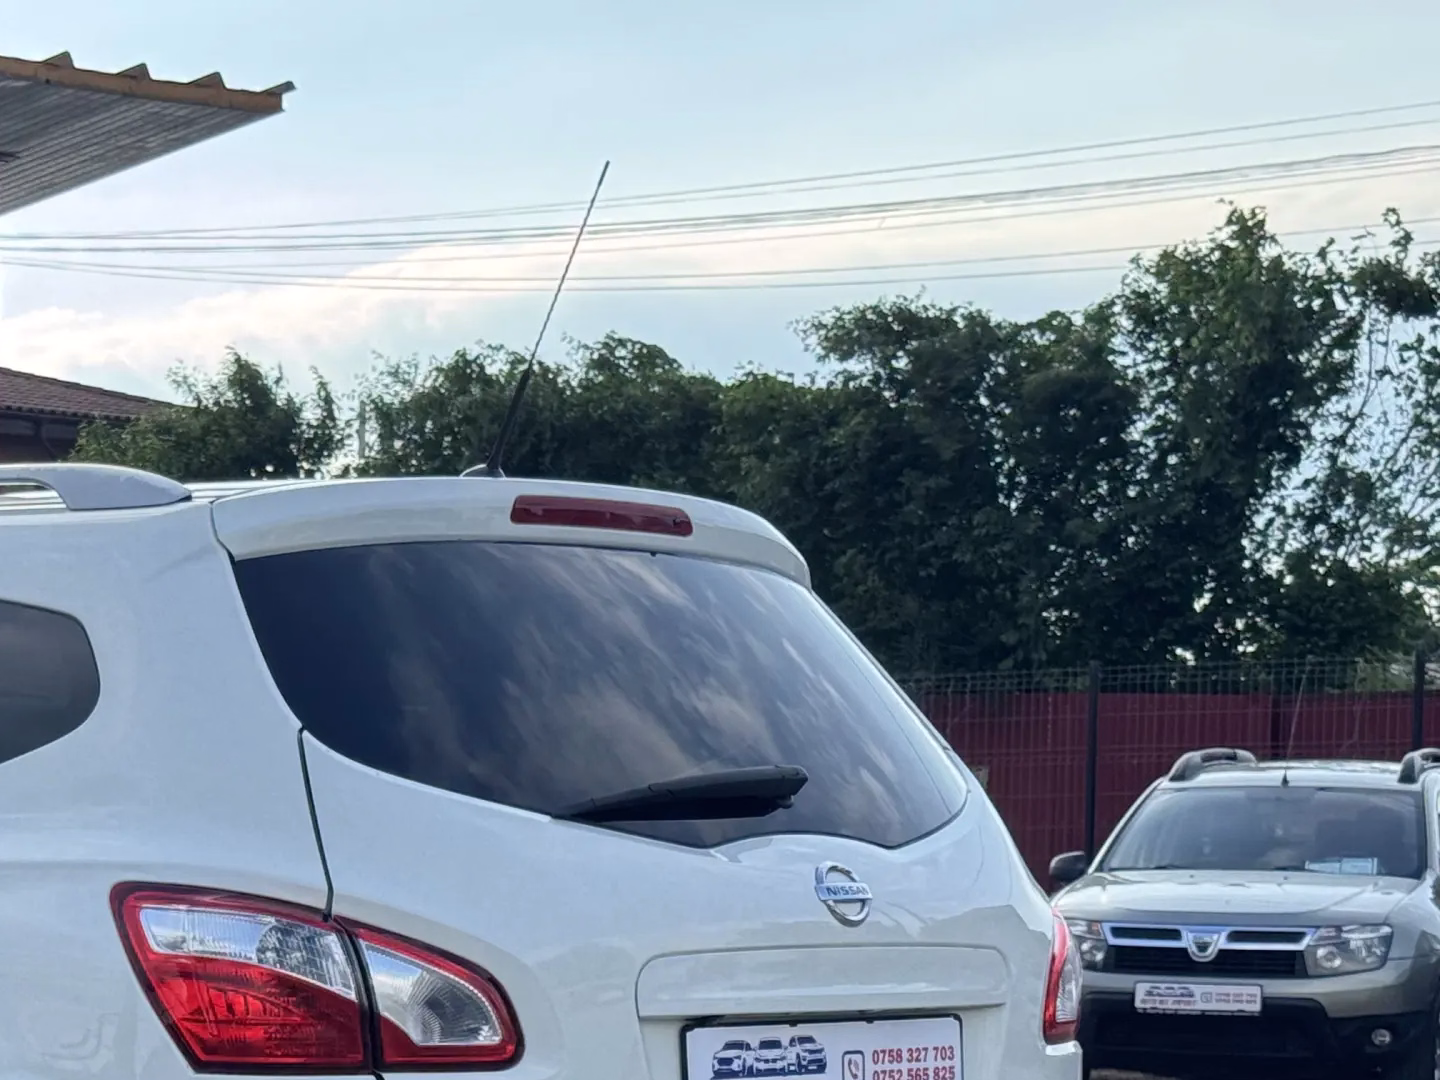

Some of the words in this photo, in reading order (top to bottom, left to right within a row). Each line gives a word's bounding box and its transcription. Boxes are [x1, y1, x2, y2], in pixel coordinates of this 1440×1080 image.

[825, 885, 870, 897] NISSAN
[872, 1048, 903, 1065] 0758
[906, 1046, 929, 1063] 327
[932, 1045, 955, 1062] 703
